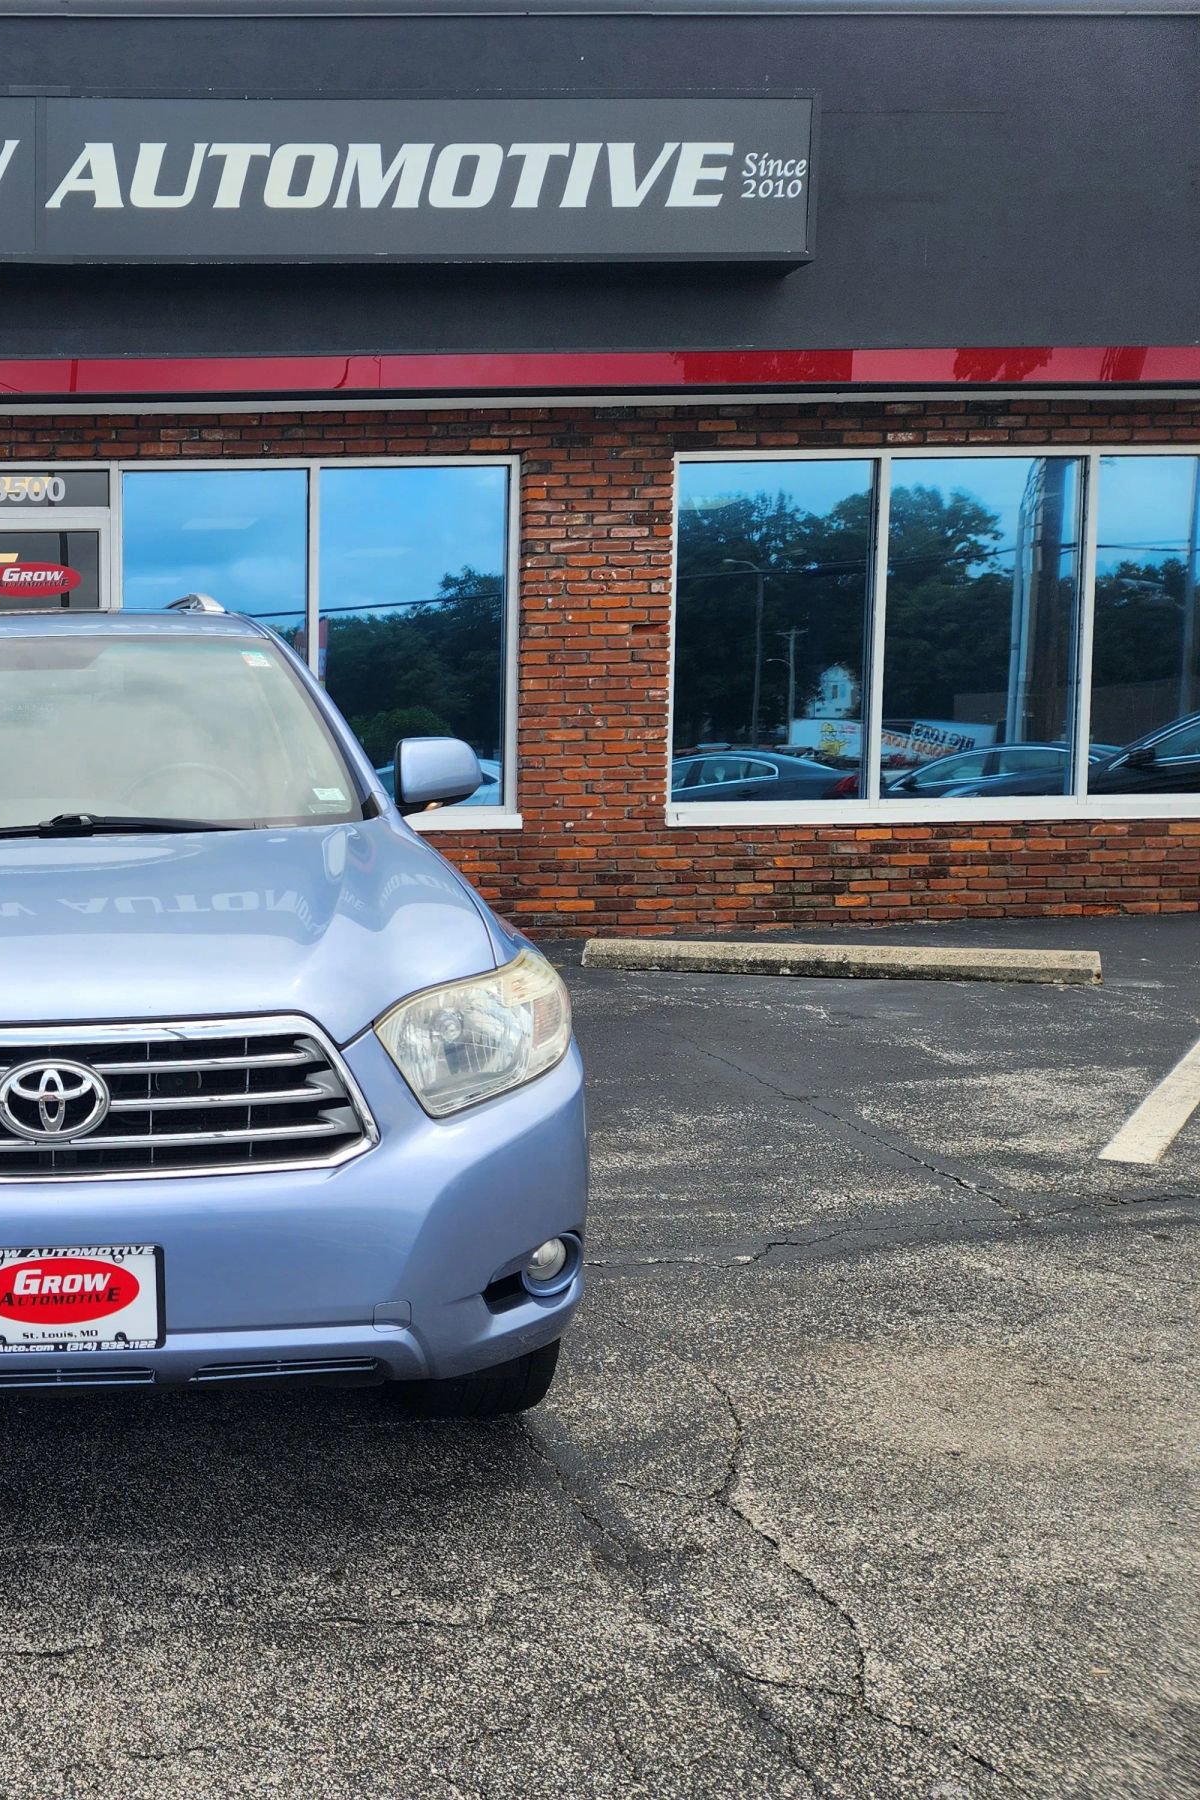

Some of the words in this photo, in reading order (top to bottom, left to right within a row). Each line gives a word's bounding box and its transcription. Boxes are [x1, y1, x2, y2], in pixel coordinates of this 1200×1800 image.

[45, 142, 735, 209] AUTOMOTIVE
[741, 178, 803, 198] 2010
[26, 1246, 154, 1258] AUTOMOTIVE
[0, 1287, 121, 1307] AUTOMOTIVE
[22, 1331, 39, 1340] St.
[41, 1330, 78, 1339] Louis,
[80, 1329, 98, 1338] MO
[66, 1342, 97, 1352] (314)
[100, 1340, 156, 1350] 932-1122
